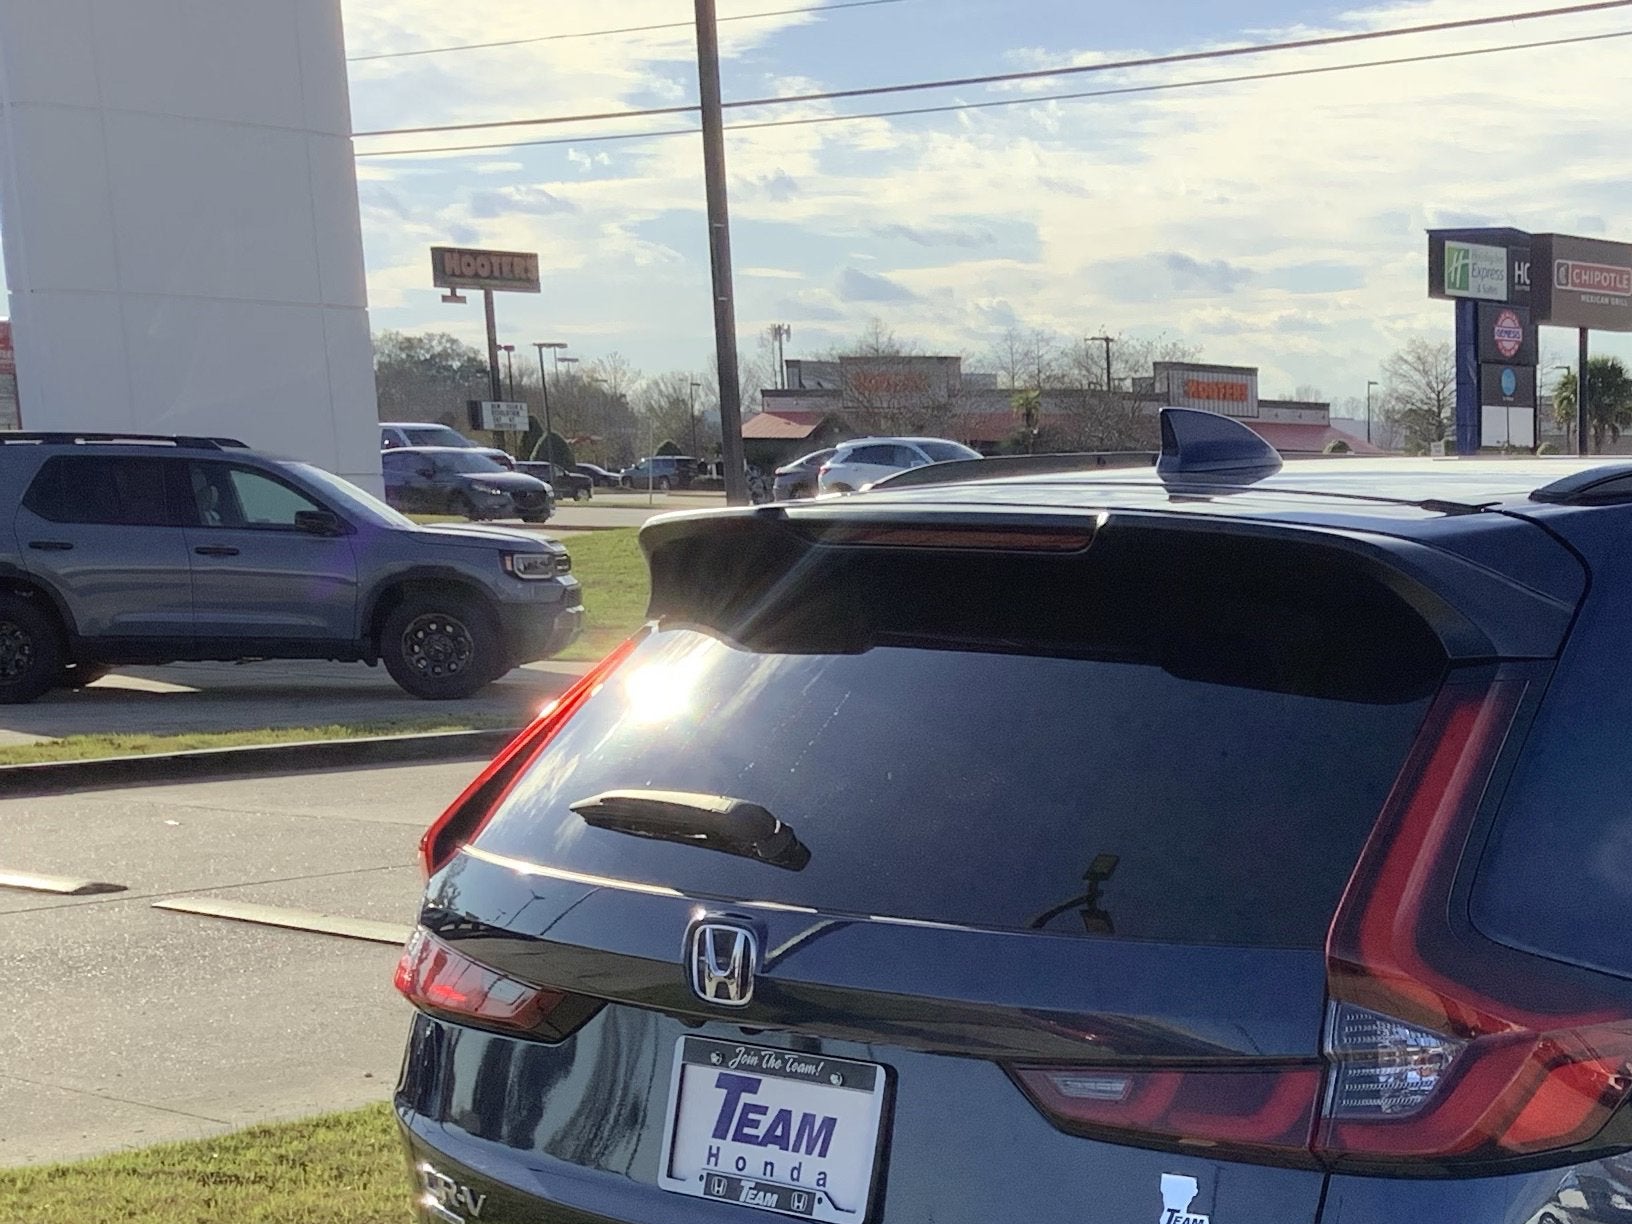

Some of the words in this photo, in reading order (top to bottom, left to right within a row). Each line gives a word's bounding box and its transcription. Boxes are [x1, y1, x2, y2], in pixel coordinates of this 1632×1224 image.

[444, 252, 539, 281] HOOTERS
[1572, 269, 1630, 289] CHIPOTLE
[728, 1046, 759, 1069] Join
[761, 1050, 783, 1069] The
[784, 1054, 825, 1076] Team!
[711, 1072, 838, 1159] TEAM
[706, 1145, 828, 1188] Honda
[738, 1179, 779, 1208] TEAM
